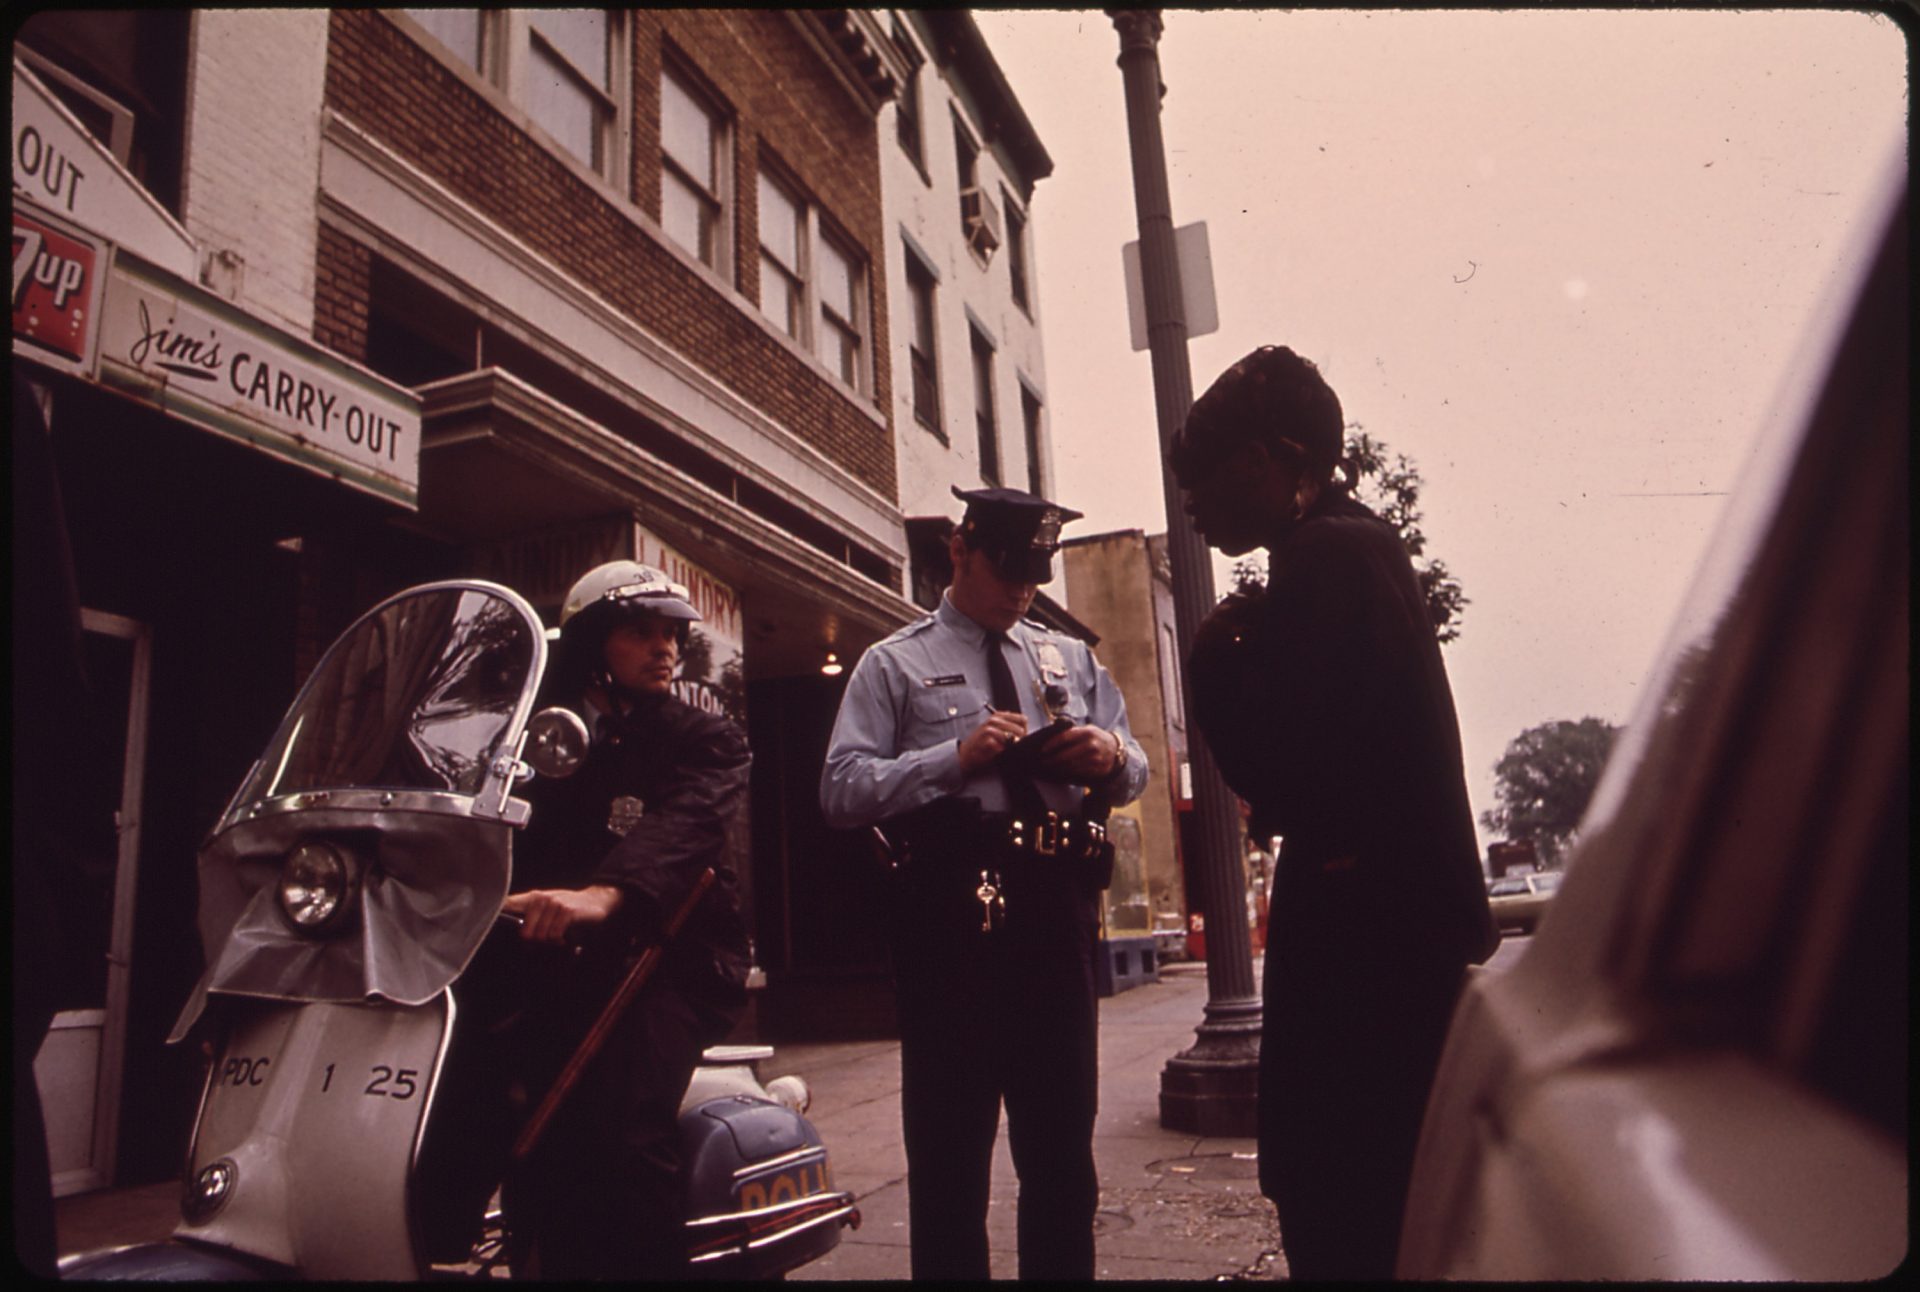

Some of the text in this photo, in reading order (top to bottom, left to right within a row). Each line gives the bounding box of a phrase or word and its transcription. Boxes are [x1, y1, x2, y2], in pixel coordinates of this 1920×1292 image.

[18, 125, 84, 212] OUT
[130, 298, 402, 461] Jim's CARRY-OUT
[223, 1057, 418, 1099] PDC 1 25
